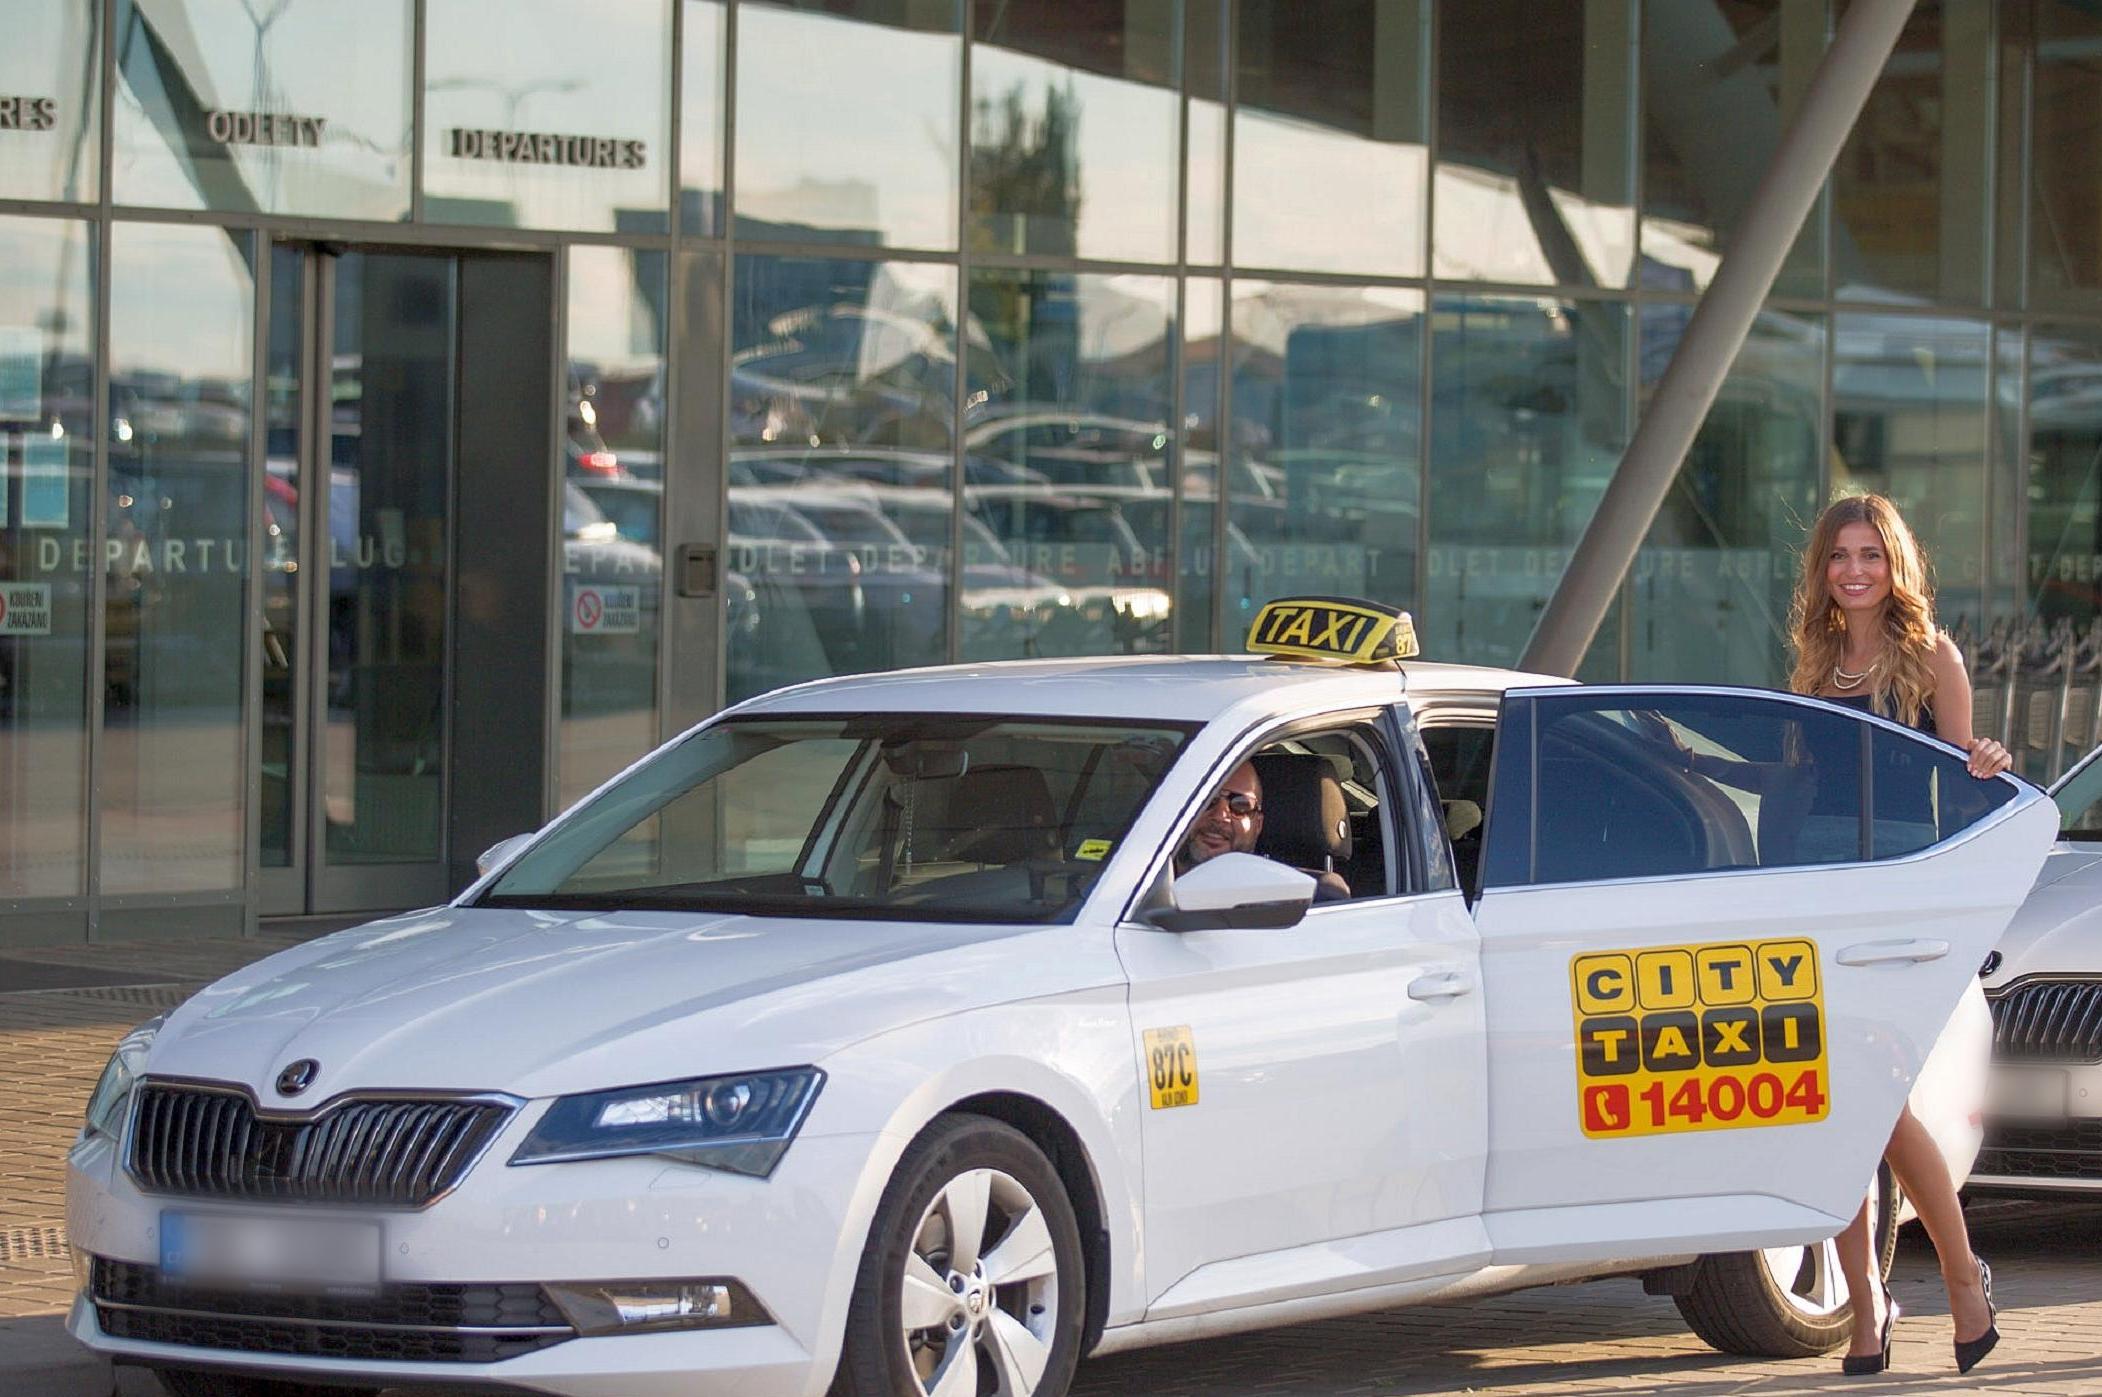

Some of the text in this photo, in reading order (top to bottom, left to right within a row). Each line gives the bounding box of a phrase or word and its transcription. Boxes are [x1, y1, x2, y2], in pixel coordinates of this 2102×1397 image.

[452, 128, 646, 169] DEPARTURES
[40, 538, 247, 573] DEPARTU
[1265, 608, 1369, 652] TAXI
[1587, 955, 1803, 1000] CITY
[1593, 1017, 1799, 1062] TAXI
[1153, 1042, 1192, 1091] 87C
[1640, 1069, 1826, 1126] 14004
